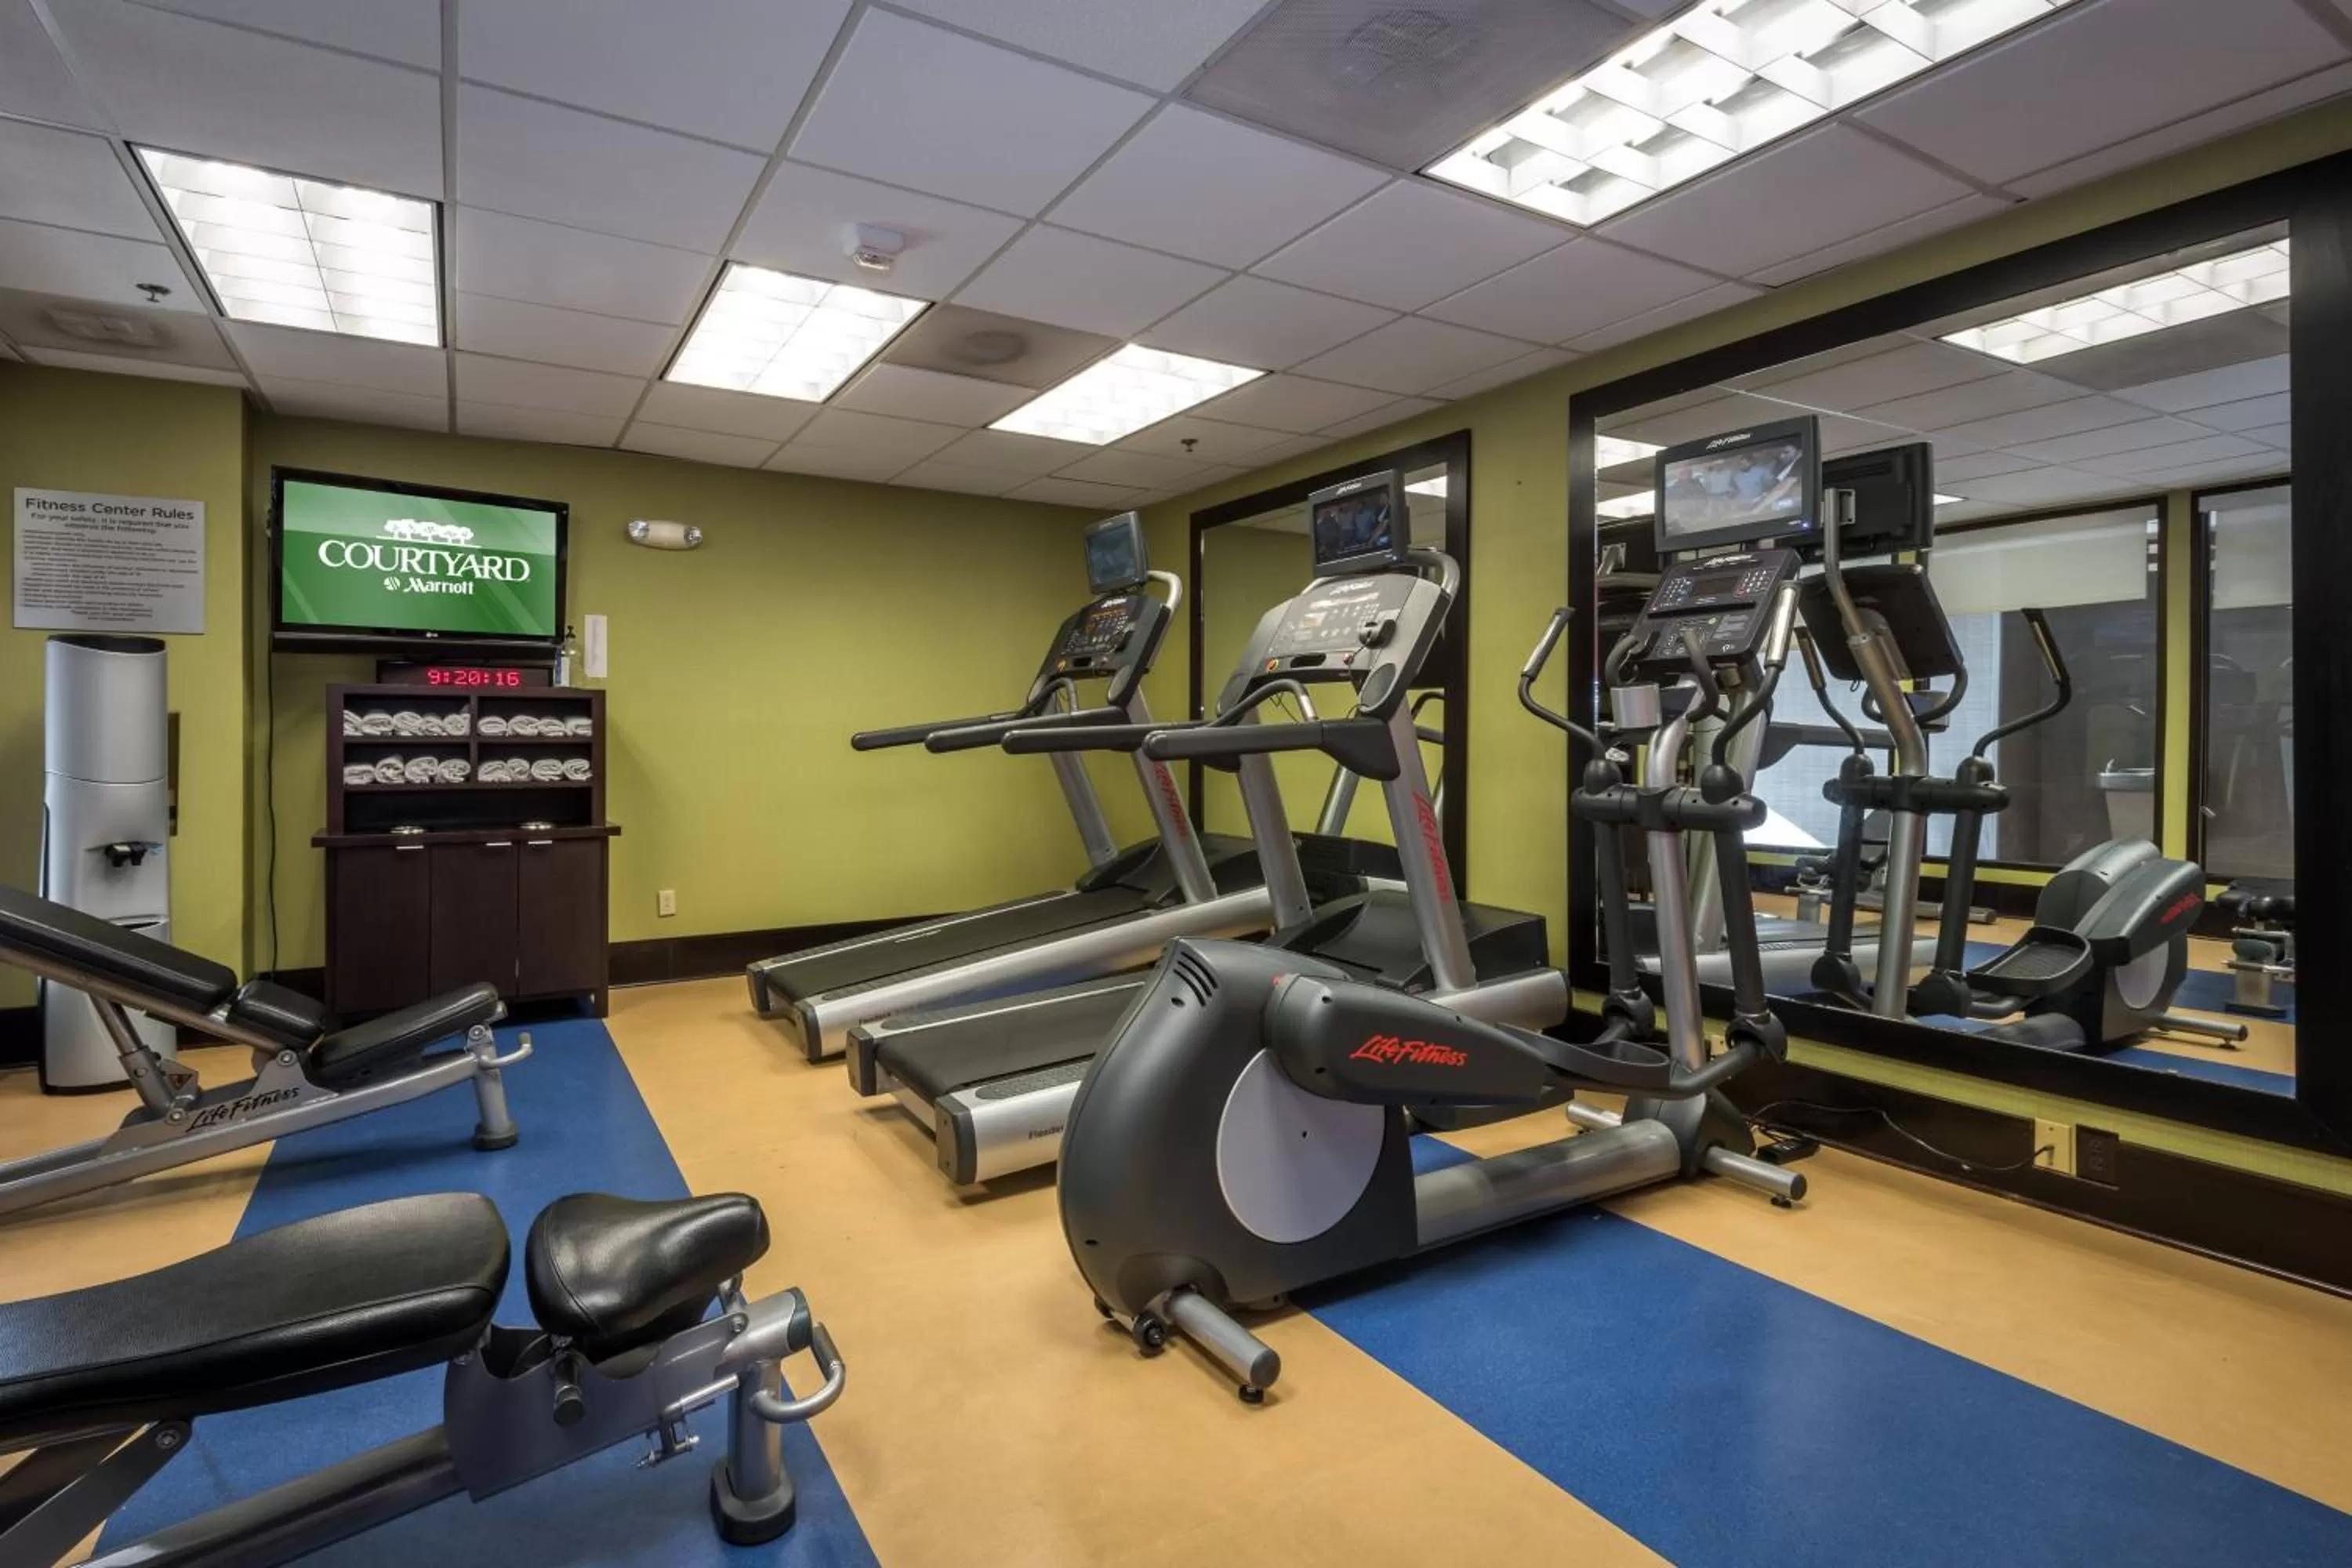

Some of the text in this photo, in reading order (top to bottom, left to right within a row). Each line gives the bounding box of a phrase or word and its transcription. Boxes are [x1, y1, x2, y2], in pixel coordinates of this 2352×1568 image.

[25, 497, 195, 521] Fitness Center Rules
[318, 539, 531, 581] COURTYARD
[403, 575, 474, 595] Marriott
[426, 669, 521, 687] 9:20:16
